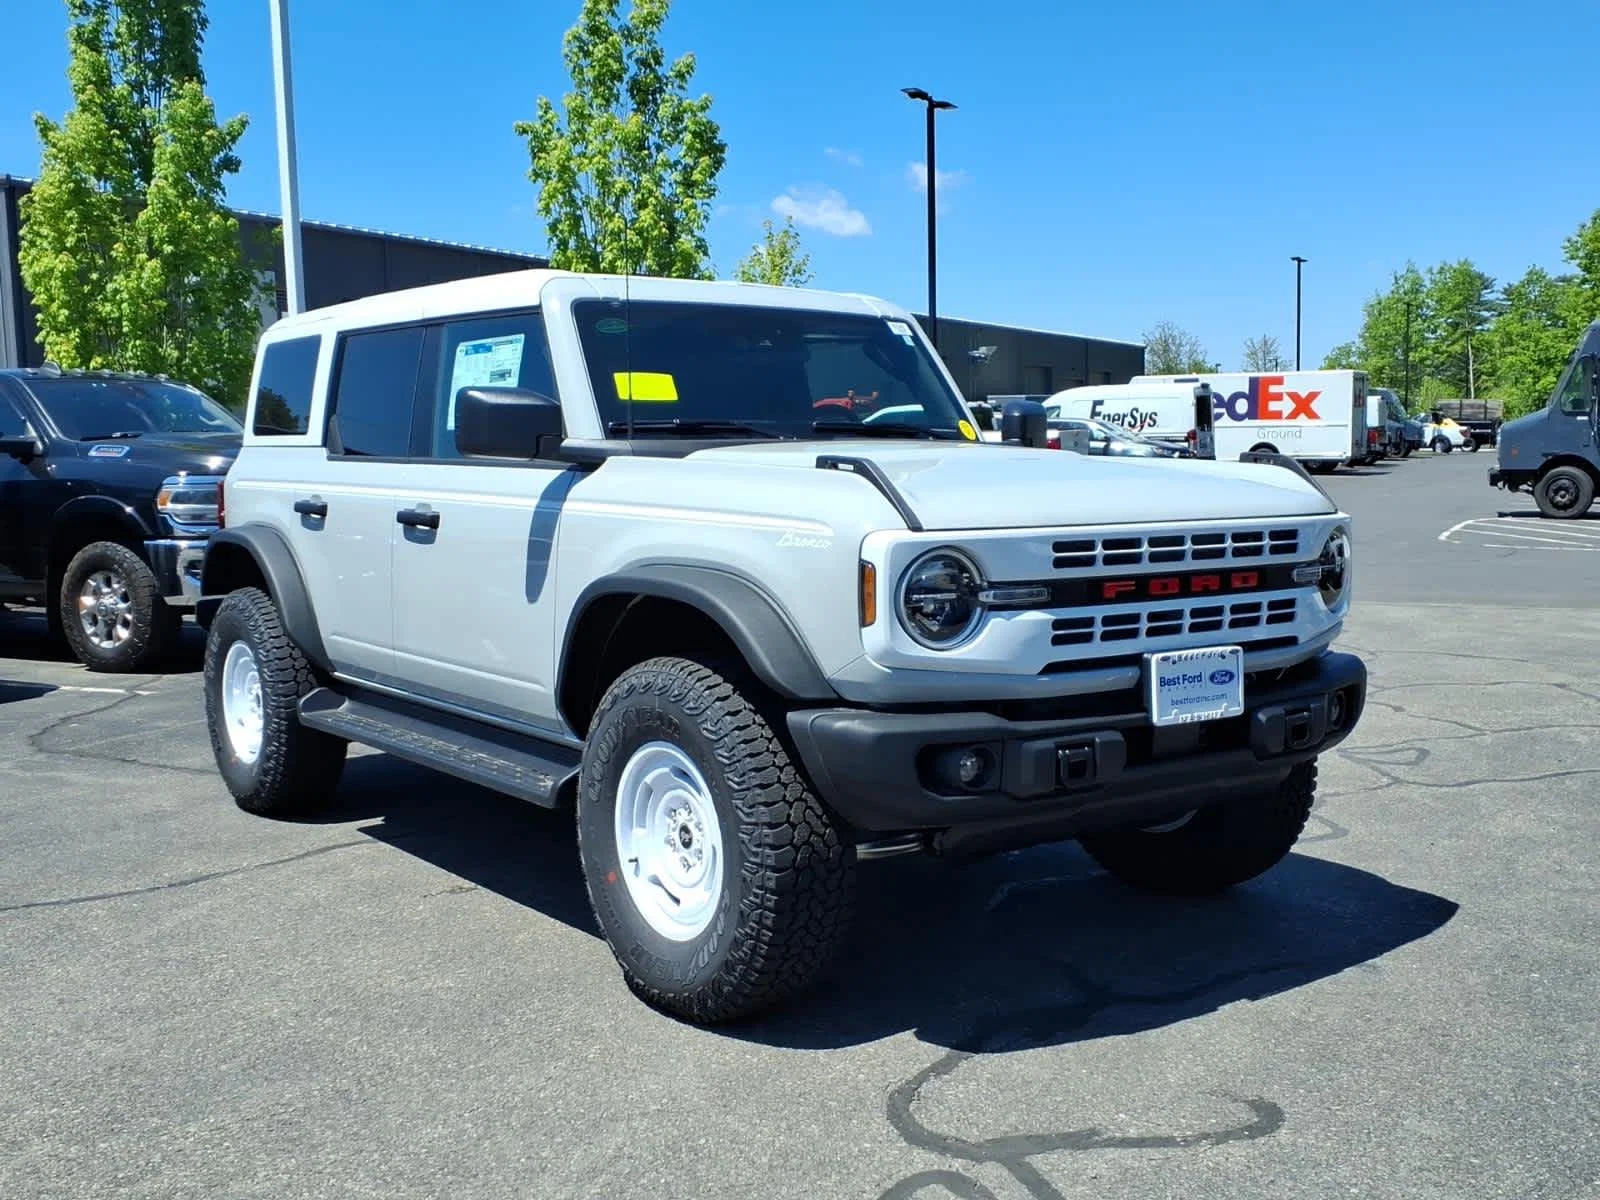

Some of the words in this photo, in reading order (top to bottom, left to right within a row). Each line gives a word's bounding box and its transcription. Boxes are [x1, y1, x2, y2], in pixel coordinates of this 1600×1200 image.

[1212, 376, 1322, 422] edEx
[1090, 399, 1158, 431] EnerSys
[1256, 427, 1303, 440] Ground
[1103, 571, 1258, 599] FORD
[1160, 675, 1180, 687] Best
[1182, 672, 1202, 684] Ford
